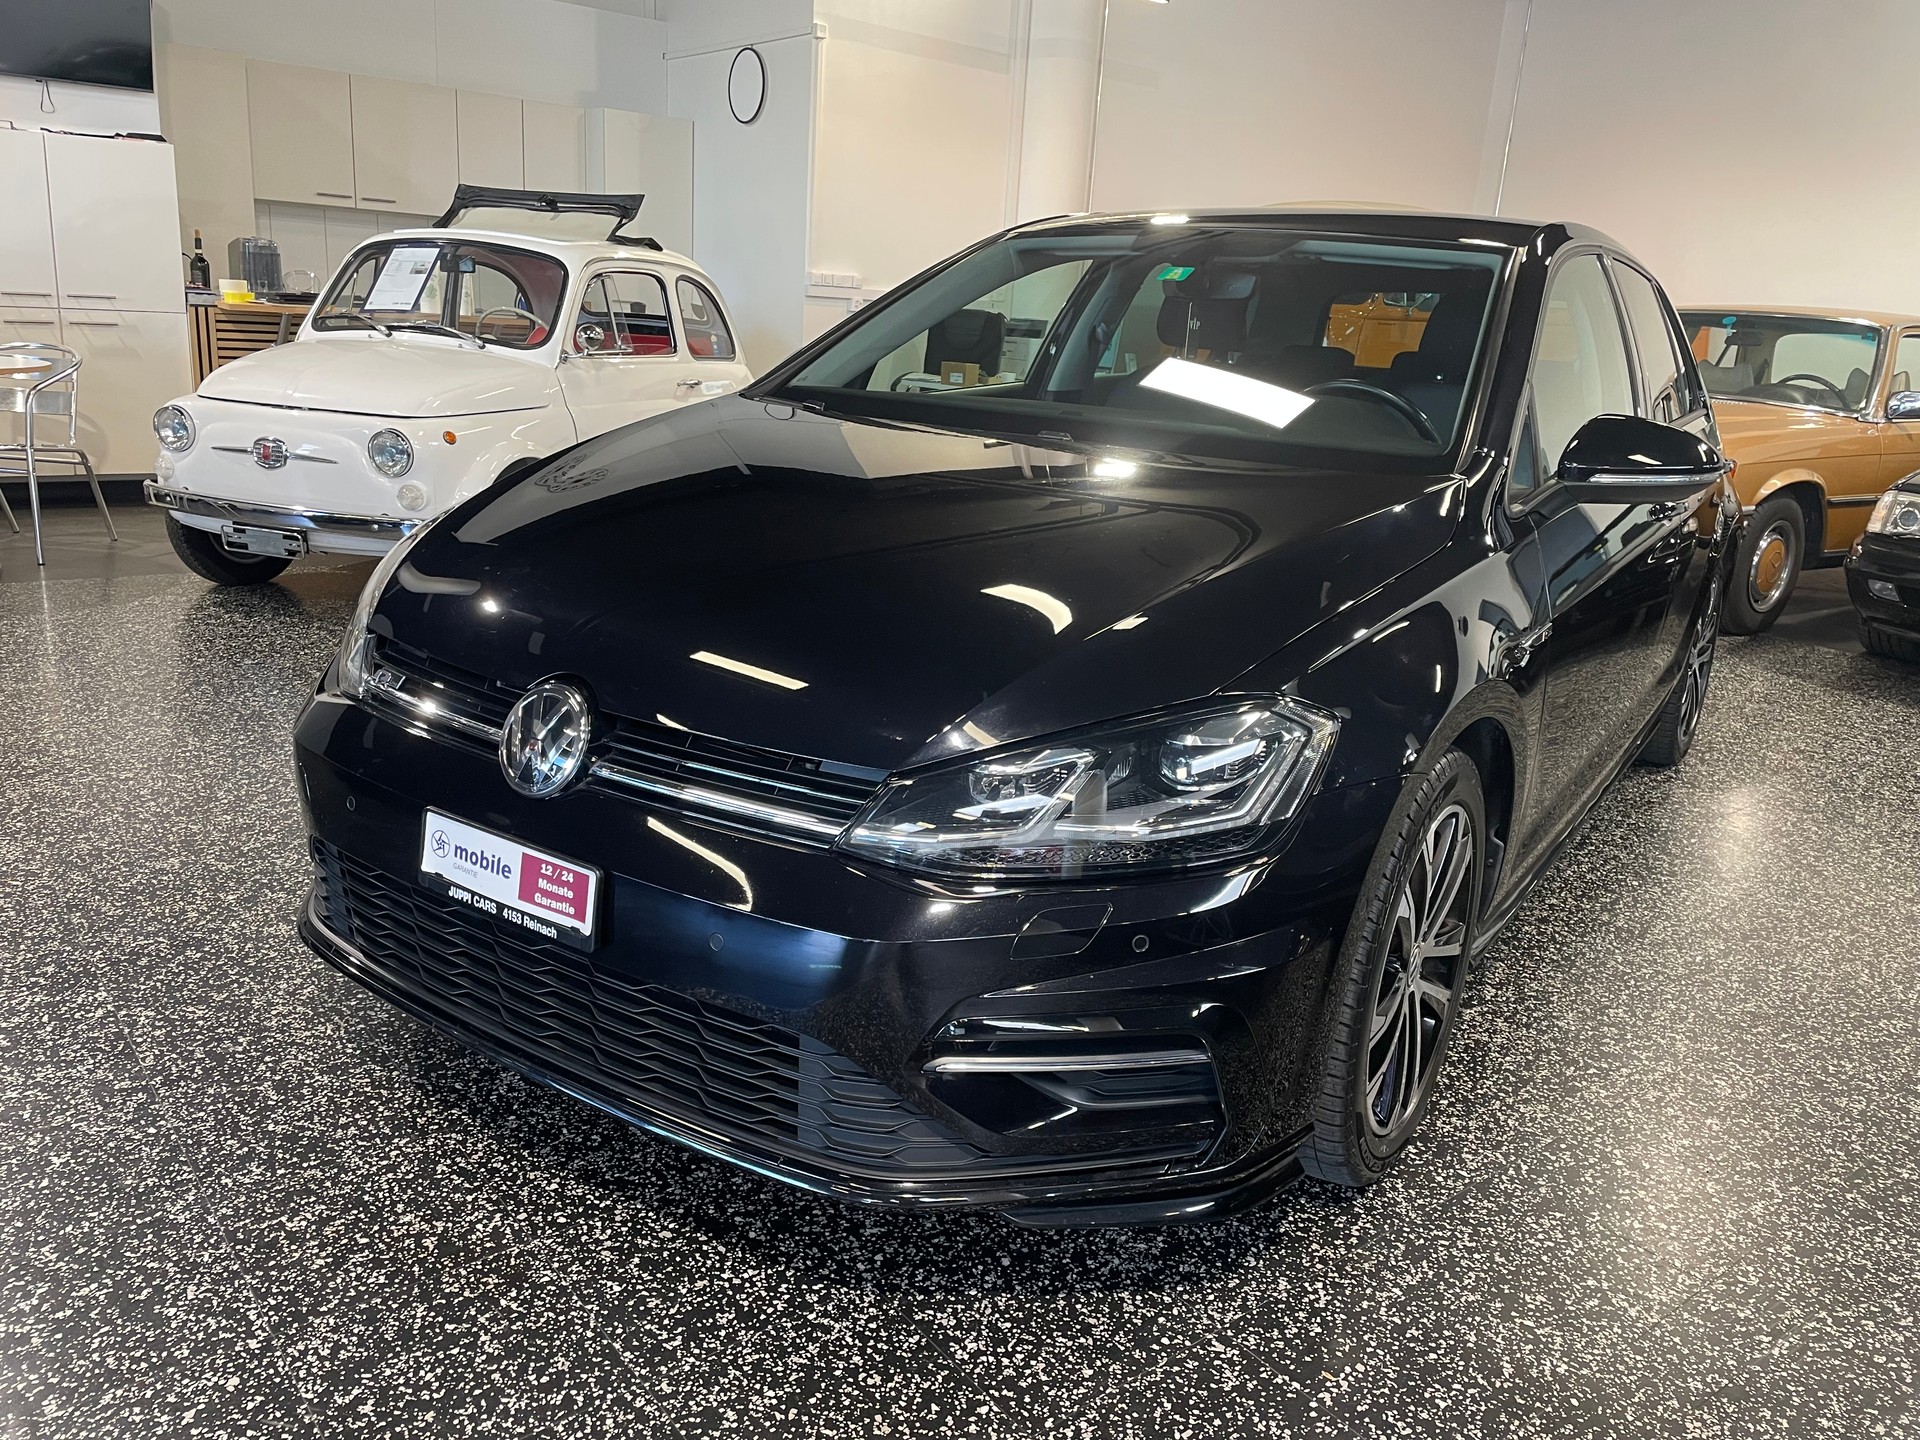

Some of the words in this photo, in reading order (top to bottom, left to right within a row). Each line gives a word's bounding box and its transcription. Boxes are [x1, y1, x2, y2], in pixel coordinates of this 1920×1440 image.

[453, 862, 479, 879] GARANTIE
[454, 844, 512, 879] mobile
[540, 863, 553, 876] 12
[561, 870, 574, 883] 24
[538, 877, 574, 899] Monate
[448, 885, 472, 905] JUPPI
[473, 895, 497, 914] CARS
[502, 907, 522, 925] 4153
[523, 915, 557, 939] Reinach
[534, 892, 575, 915] Garantie
